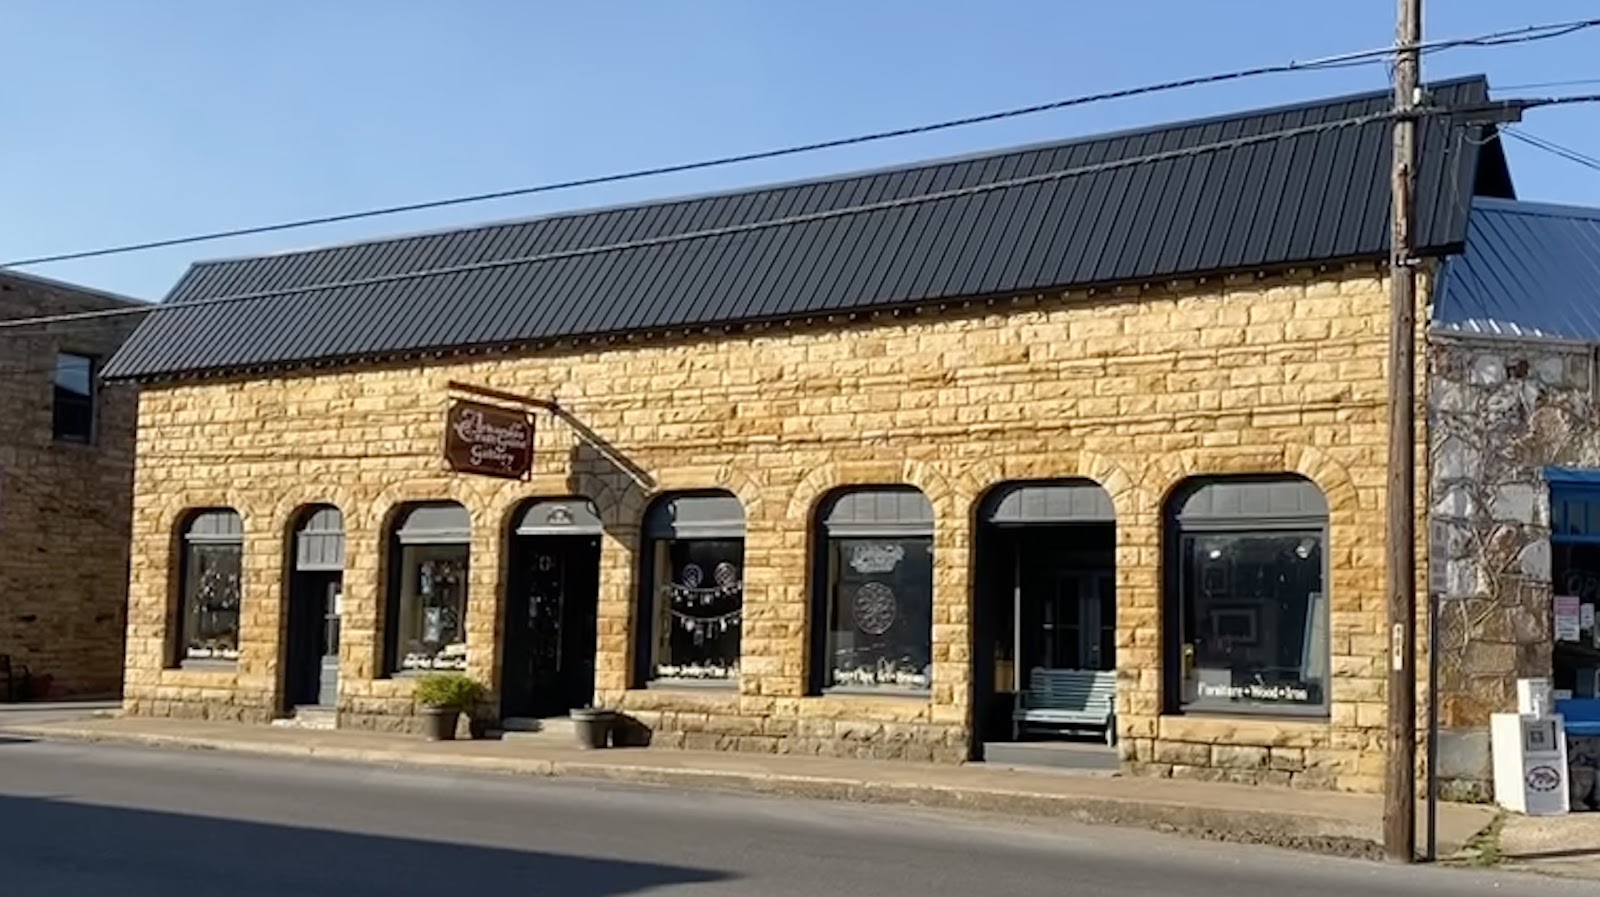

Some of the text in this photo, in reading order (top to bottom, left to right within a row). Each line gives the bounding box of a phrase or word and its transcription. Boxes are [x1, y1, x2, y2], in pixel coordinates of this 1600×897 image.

[1198, 682, 1307, 699] Furniture Wood Iron
